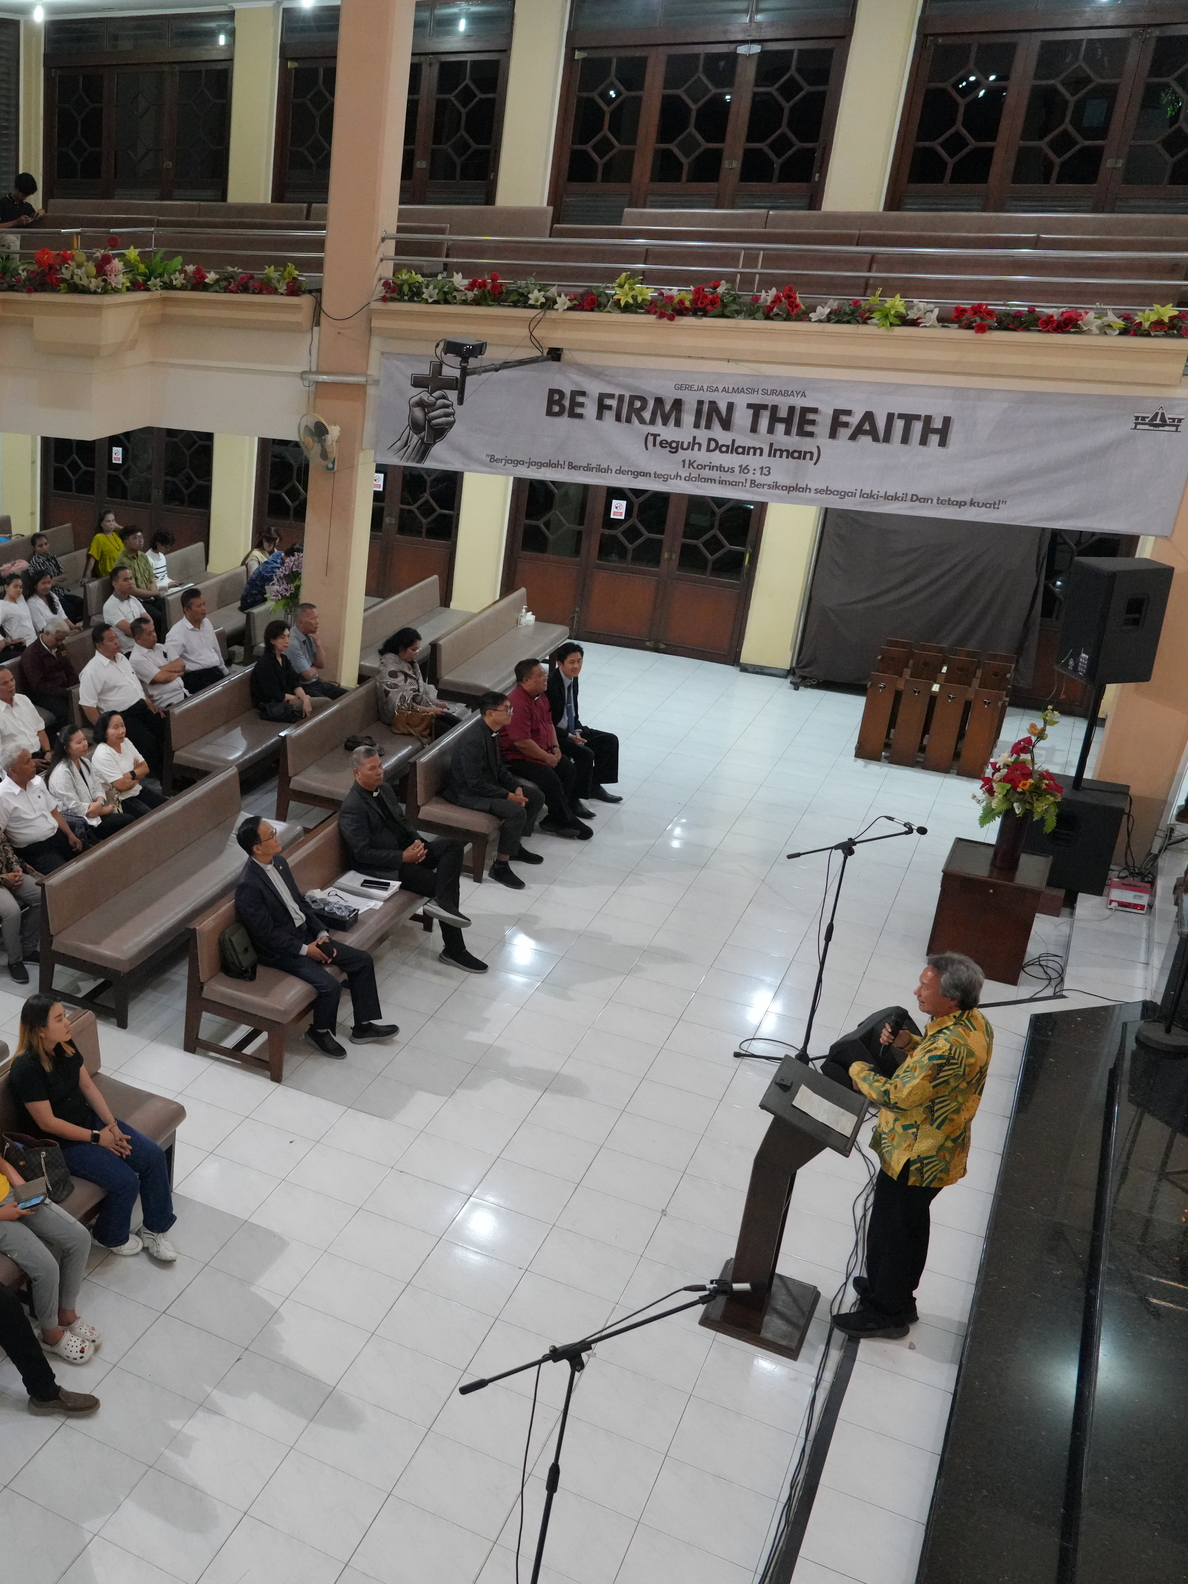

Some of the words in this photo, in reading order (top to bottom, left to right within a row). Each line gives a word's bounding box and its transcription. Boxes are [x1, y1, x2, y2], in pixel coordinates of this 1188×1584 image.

[674, 384, 704, 392] GEREJA
[721, 386, 759, 396] ALMASIH
[761, 388, 807, 398] SURABAYA
[545, 388, 587, 419] BE
[596, 392, 683, 428] FIRM
[693, 400, 735, 432] IN
[746, 402, 819, 438] THE
[828, 408, 952, 448] FAITH
[644, 432, 702, 454] (Teguh
[706, 438, 763, 458] Dalam
[768, 442, 821, 466] Iman)
[486, 454, 566, 470] "Berjaga-jagalah!
[568, 462, 612, 474] Berdirilah
[615, 466, 652, 479] dengan
[653, 470, 682, 482] teguh
[684, 473, 716, 485] dalam
[718, 476, 747, 488] iman!
[749, 480, 812, 494] Bersikaplah
[814, 486, 857, 499] sebagai
[859, 489, 908, 502] laki-laki!
[910, 494, 934, 504] Dan
[936, 497, 967, 508] tetap
[969, 498, 1007, 510] kuat!"
[681, 459, 686, 468] 1
[688, 459, 735, 474] Korintus
[738, 464, 750, 475] 16
[759, 466, 772, 476] 13
